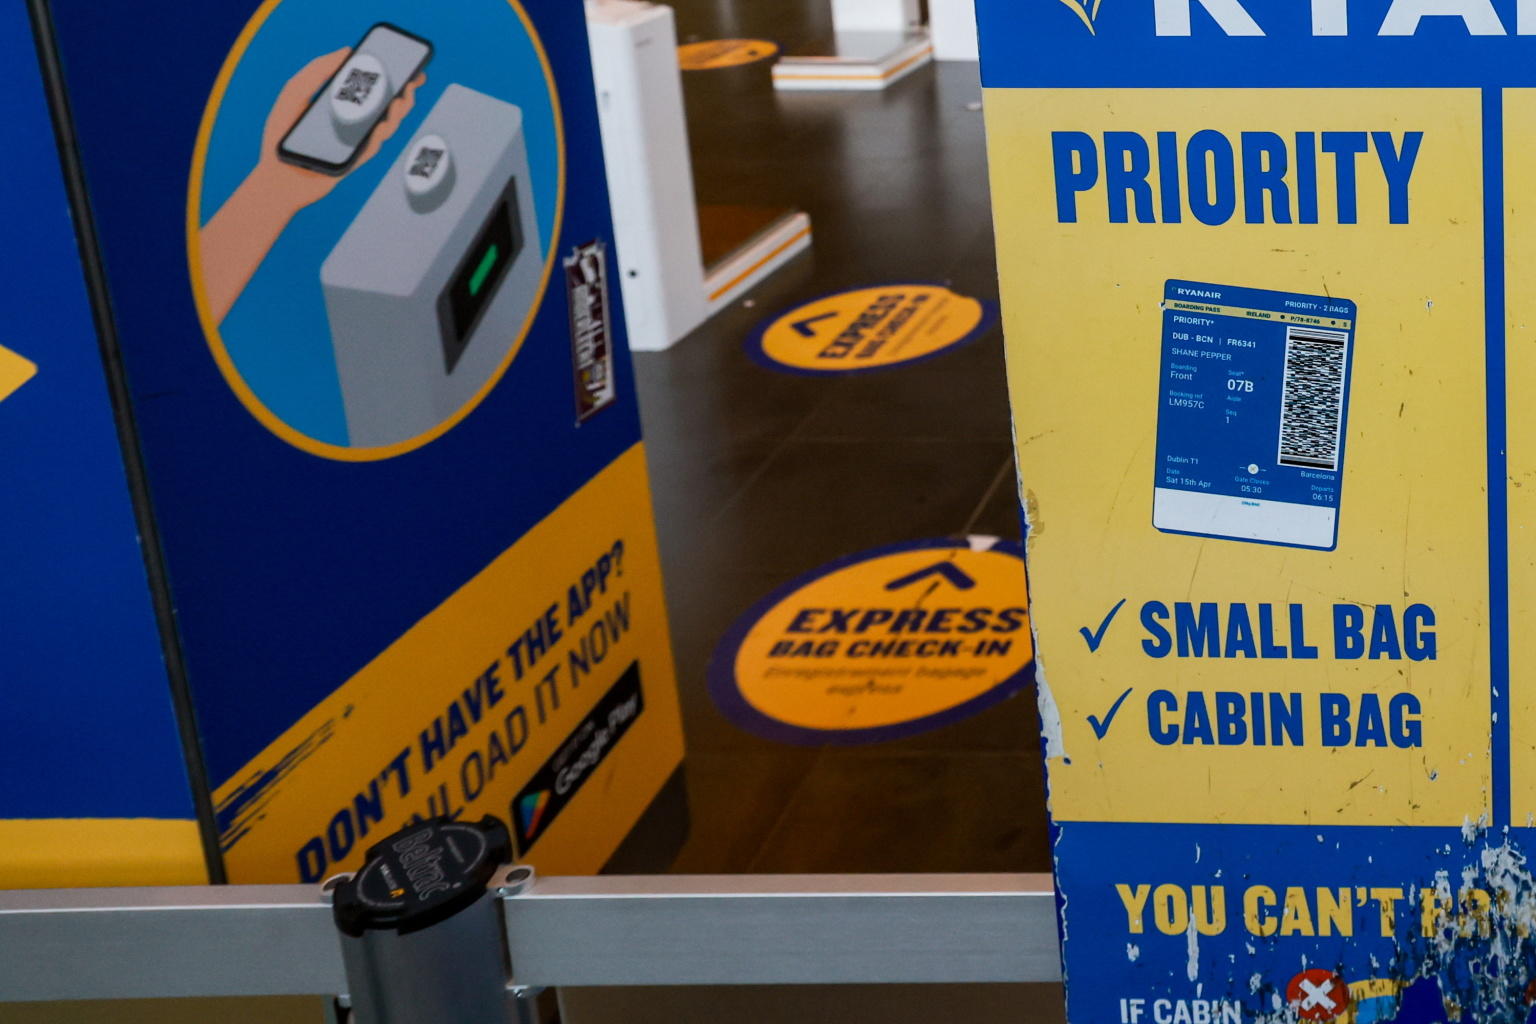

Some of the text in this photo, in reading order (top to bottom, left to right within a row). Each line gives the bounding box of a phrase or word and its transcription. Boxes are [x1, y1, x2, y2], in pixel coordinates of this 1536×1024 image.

[1051, 129, 1424, 226] PRIORITY
[1177, 287, 1221, 299] RYANAIR
[1173, 302, 1204, 311] BOARDING
[1205, 305, 1221, 313] PASS
[1285, 300, 1318, 310] PRIORITY
[1323, 304, 1328, 312] 2
[1172, 332, 1256, 348] DUB BCN FR6341
[1171, 347, 1232, 361] SHANE PEPPER
[1170, 370, 1192, 380] Front
[1227, 378, 1254, 392] 07B
[1168, 397, 1205, 409] LM957C
[1166, 476, 1211, 488] Sat 15th Apr
[785, 606, 1027, 635] EXPRESS
[1140, 600, 1437, 662] SMALL BAG
[766, 639, 1012, 658] BAG CHECK-IN
[534, 663, 562, 724] IT
[567, 591, 631, 689] NOW
[295, 746, 411, 884] DON'T
[419, 659, 505, 774] HAVE
[506, 601, 562, 681] THE
[566, 539, 625, 627] APP?
[1147, 689, 1423, 749] CABIN BAG
[1115, 883, 1226, 936] YOU
[1243, 884, 1403, 937] CAN'T
[1120, 998, 1242, 1024] IF CABIN
